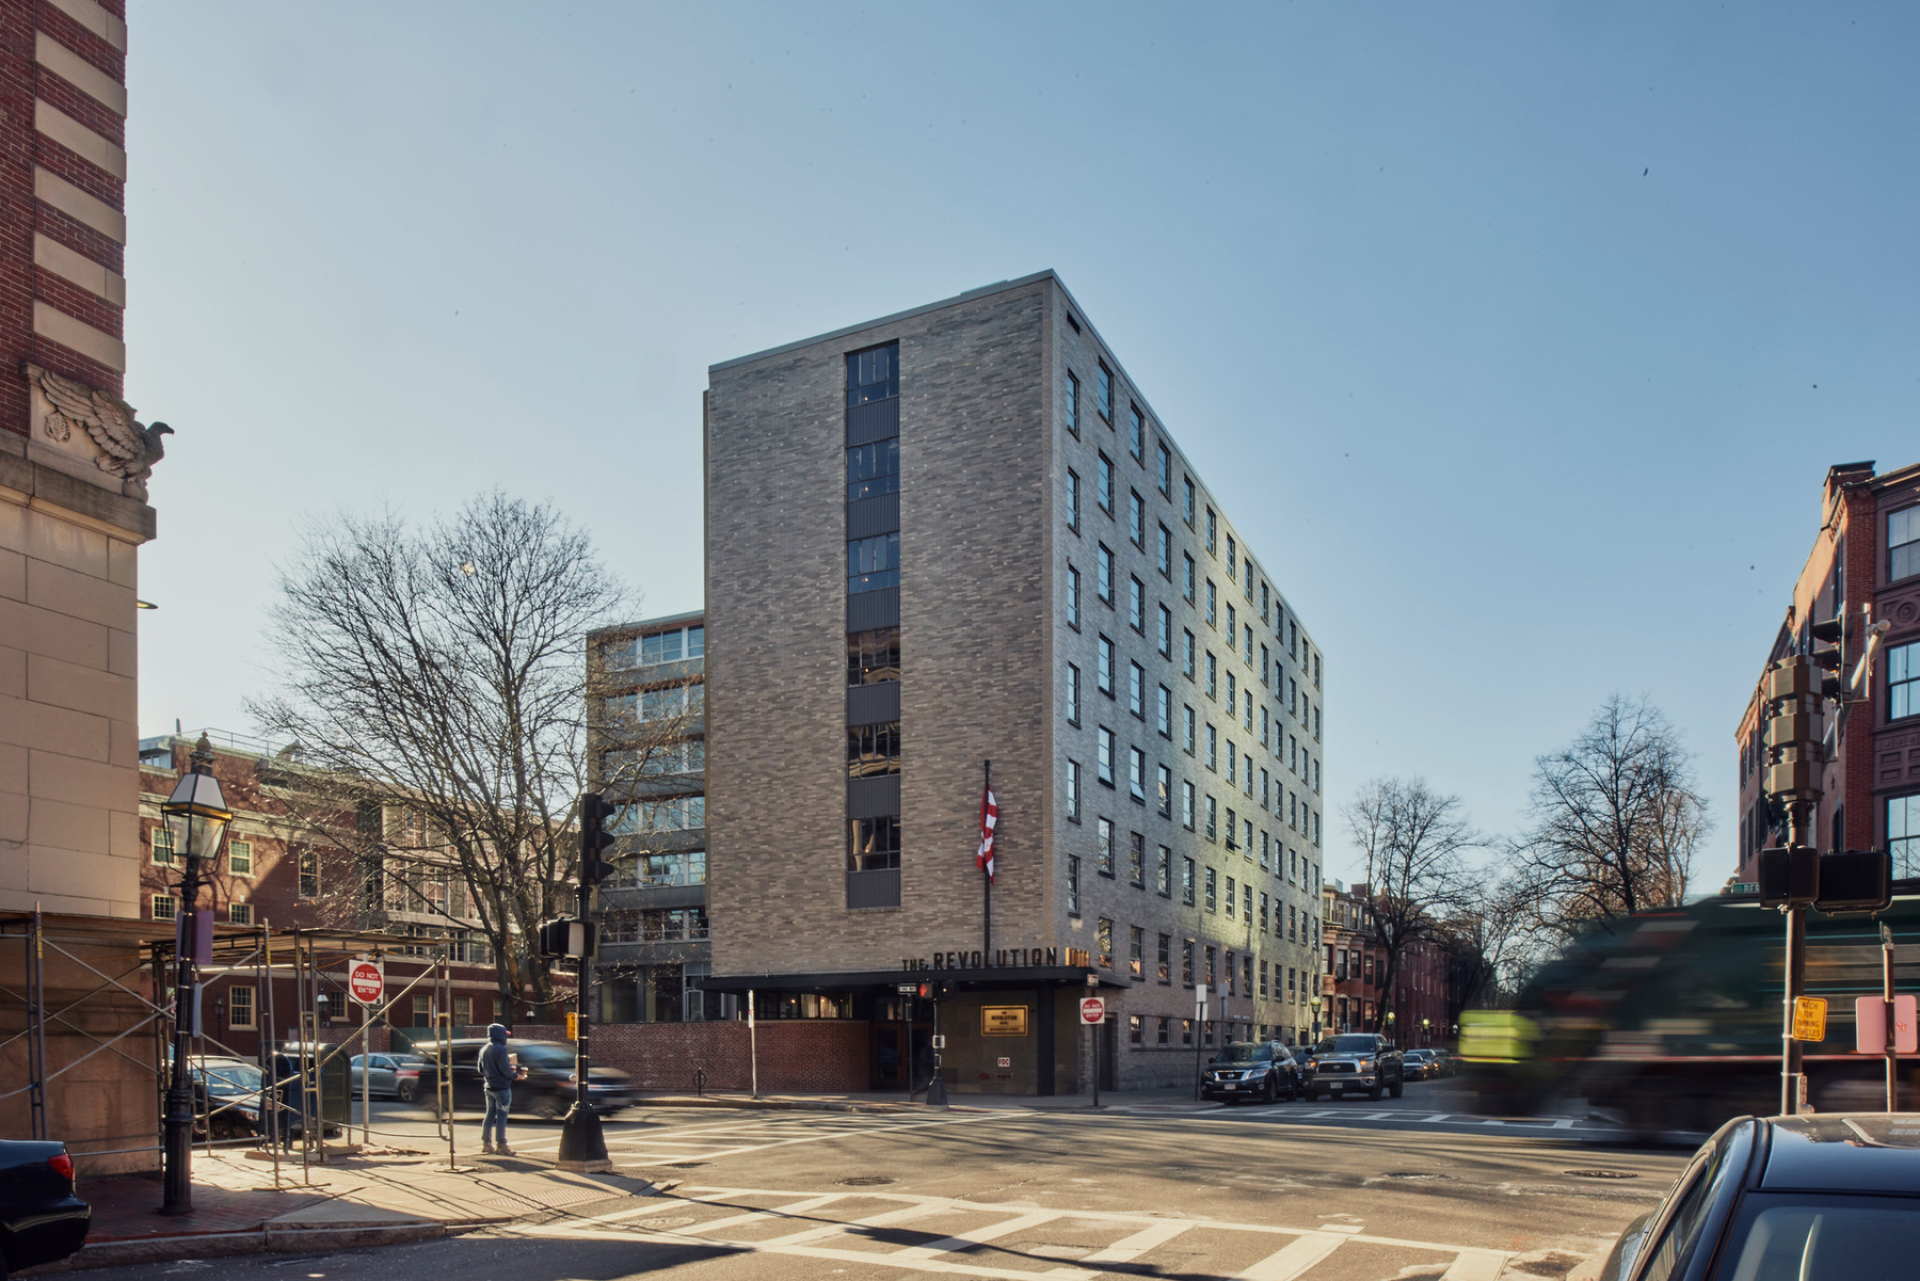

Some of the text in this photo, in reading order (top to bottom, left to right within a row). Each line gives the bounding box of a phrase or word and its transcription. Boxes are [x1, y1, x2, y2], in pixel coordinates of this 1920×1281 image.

[902, 959, 925, 971] THE
[933, 947, 1058, 970] REVOLUTION
[366, 972, 379, 980] NOT
[357, 987, 377, 995] ENTER
